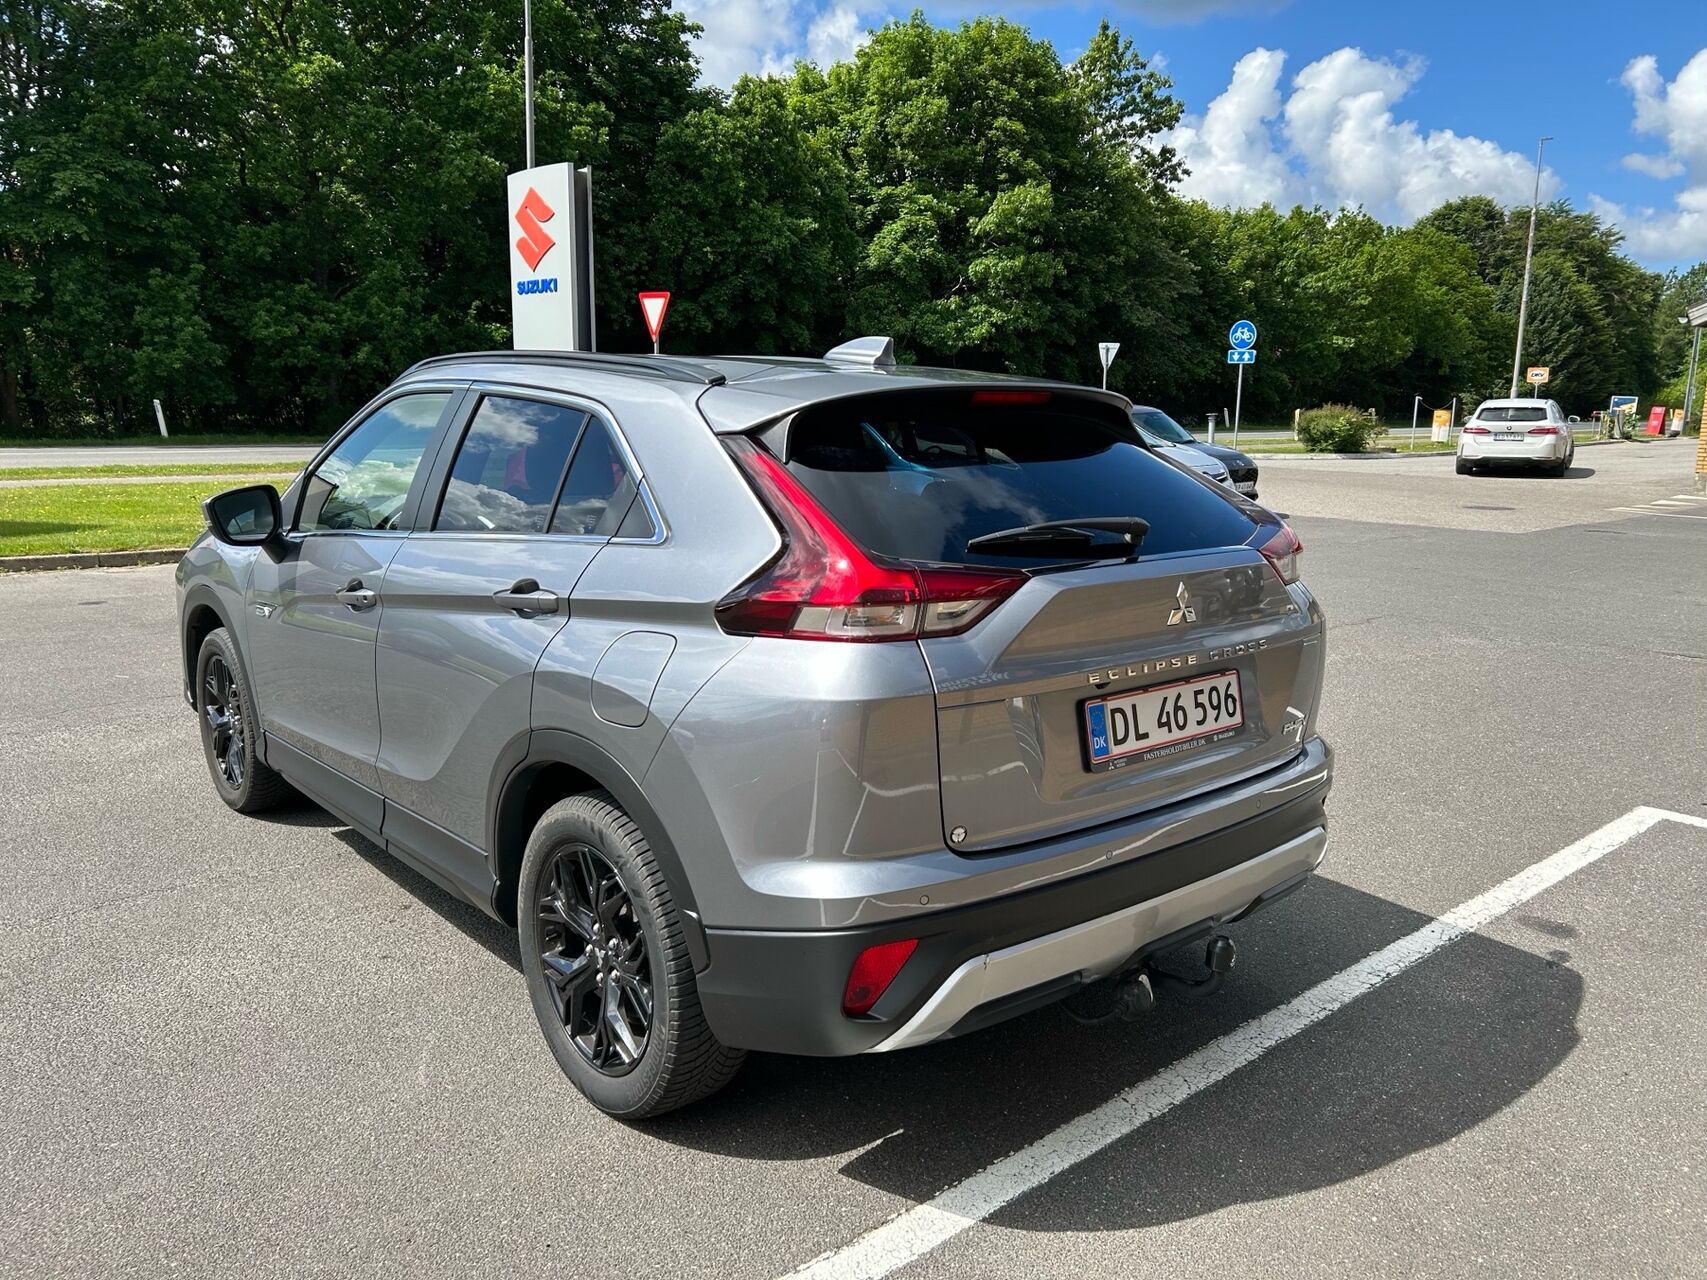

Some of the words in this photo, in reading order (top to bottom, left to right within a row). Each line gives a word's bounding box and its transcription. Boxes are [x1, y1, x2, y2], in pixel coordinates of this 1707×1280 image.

[516, 278, 558, 295] SUZUKI
[1087, 655, 1197, 684] ECLIPSE
[1208, 639, 1268, 661] CROSS
[1109, 702, 1149, 746] DL
[1156, 692, 1188, 734] 46
[1193, 680, 1237, 727] 596
[1093, 735, 1107, 749] DK
